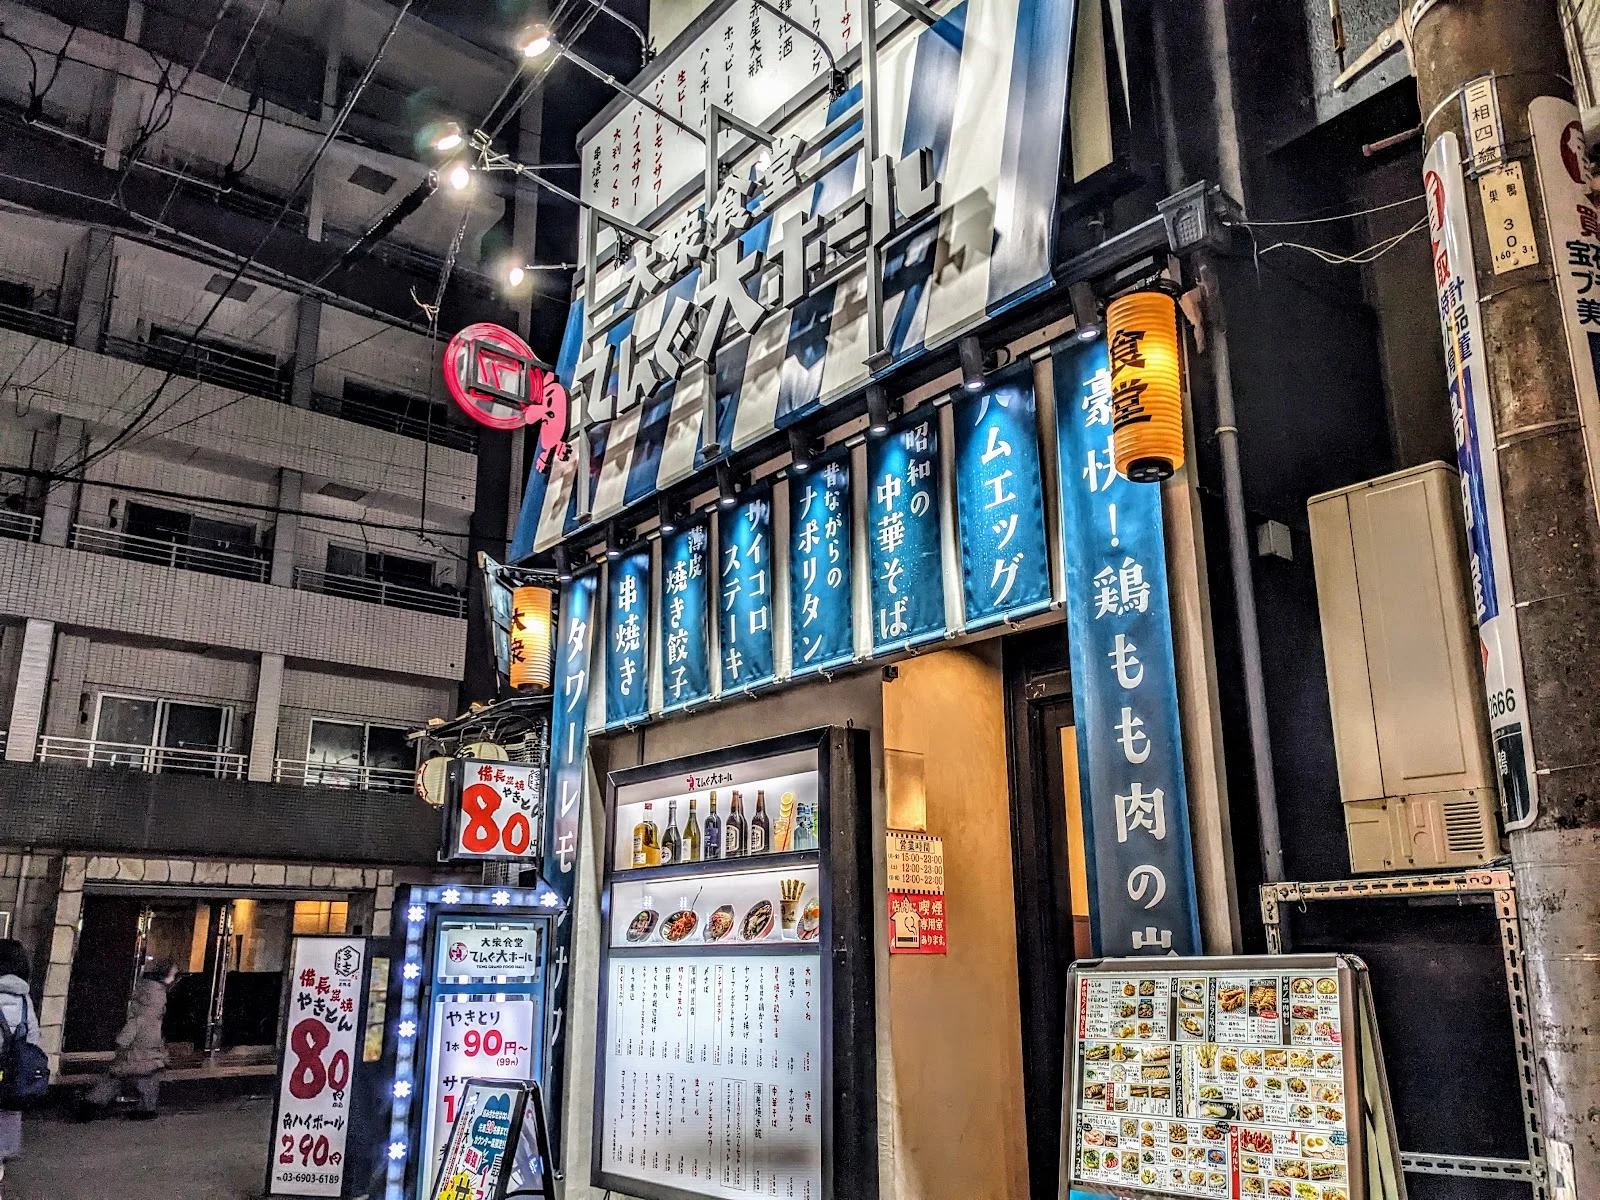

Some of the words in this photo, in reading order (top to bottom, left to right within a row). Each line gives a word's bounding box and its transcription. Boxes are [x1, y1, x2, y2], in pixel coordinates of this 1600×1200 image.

[810, 0, 822, 76] ークング
[700, 47, 711, 129] ハイボール
[623, 133, 806, 309] 大衆食堂
[575, 147, 942, 424] てんぐ大ホール
[1571, 270, 1600, 295] ブ
[1108, 327, 1154, 434] 食堂
[905, 420, 932, 518] 昭和の
[974, 394, 1025, 607] ハムエッグ
[688, 525, 703, 580] 薄皮
[823, 462, 844, 589] 昔ながらの
[876, 472, 910, 641] 中華そば
[744, 500, 768, 635] サイコロ
[798, 485, 824, 663] ナポリタン
[615, 574, 641, 696] 串焼き
[667, 560, 690, 699] 焼き餃子
[722, 544, 743, 680] ステーキ
[695, 772, 733, 788] てんぐ大ホール
[462, 783, 531, 855] 80
[899, 839, 931, 853] 営業時間
[480, 937, 525, 948] 大衆食堂
[918, 899, 944, 916] 喫煙
[920, 919, 944, 931] 専用室
[921, 934, 946, 946] あります。
[469, 949, 534, 963] てんぐ大ホール
[297, 991, 353, 1032] やきとん
[445, 1040, 460, 1052] 1本
[446, 1010, 501, 1027] やきとり
[289, 1018, 349, 1100] 80
[282, 1112, 345, 1132] 角ハイボール
[282, 1172, 340, 1184] 03-6903-6189
